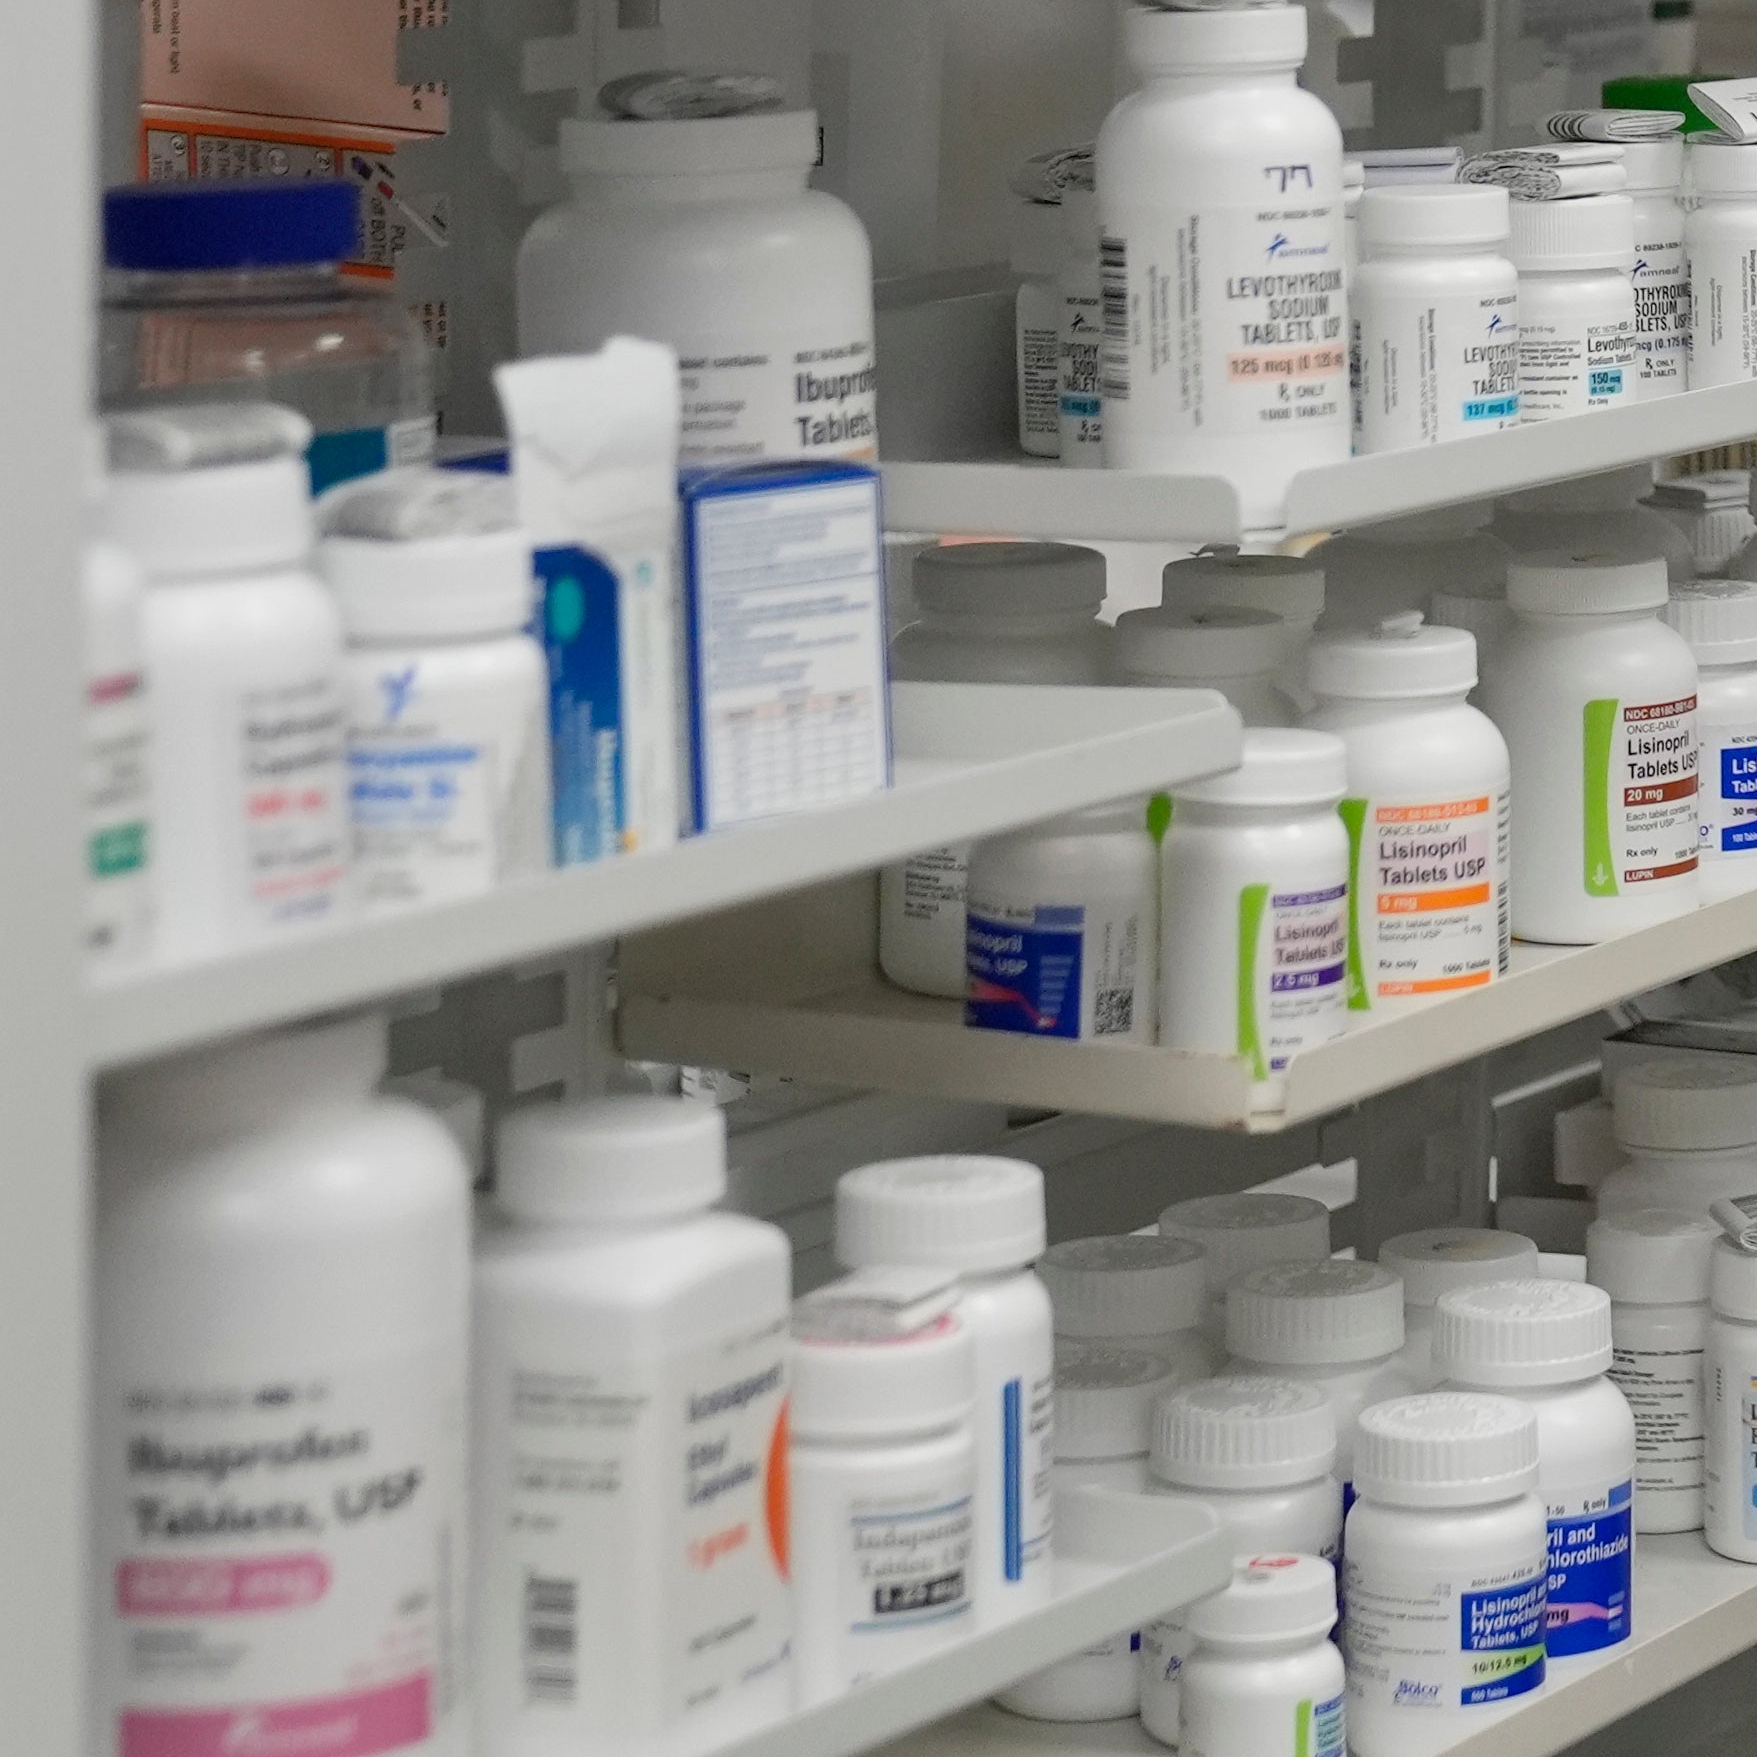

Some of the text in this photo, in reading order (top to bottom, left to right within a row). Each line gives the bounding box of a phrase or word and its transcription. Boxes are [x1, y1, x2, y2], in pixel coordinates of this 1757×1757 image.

[1639, 266, 1679, 277] amneal
[1268, 296, 1330, 320] SODIUM
[1635, 301, 1677, 317] SODIUM
[1241, 322, 1320, 345] TABLETS,
[1231, 356, 1293, 376] 125 mcg
[1587, 356, 1614, 366] Sodium
[1591, 372, 1621, 384] 150 mcg
[1296, 402, 1337, 417] TABLETS
[1467, 402, 1484, 417] 137
[1626, 709, 1649, 719] NDC
[1627, 719, 1680, 735] ONCE-DAILY
[1628, 730, 1689, 756] Lisinopril
[1627, 760, 1678, 780] Tablets
[1627, 788, 1663, 801] 20 mg
[1626, 813, 1647, 822] Each
[1649, 809, 1668, 819] tablet
[1732, 807, 1744, 816] 30
[1626, 818, 1675, 832] lisinopril USP
[1379, 836, 1467, 860] Lisinopril
[1626, 846, 1658, 858] Rx only
[1379, 858, 1486, 886] Tablets USP
[1626, 870, 1654, 881] LUPIN
[1381, 896, 1418, 910] 5 mg
[1567, 1523, 1596, 1544] and
[1471, 1590, 1536, 1616] Lisinopril
[1471, 1624, 1540, 1650] Tablets, USP
